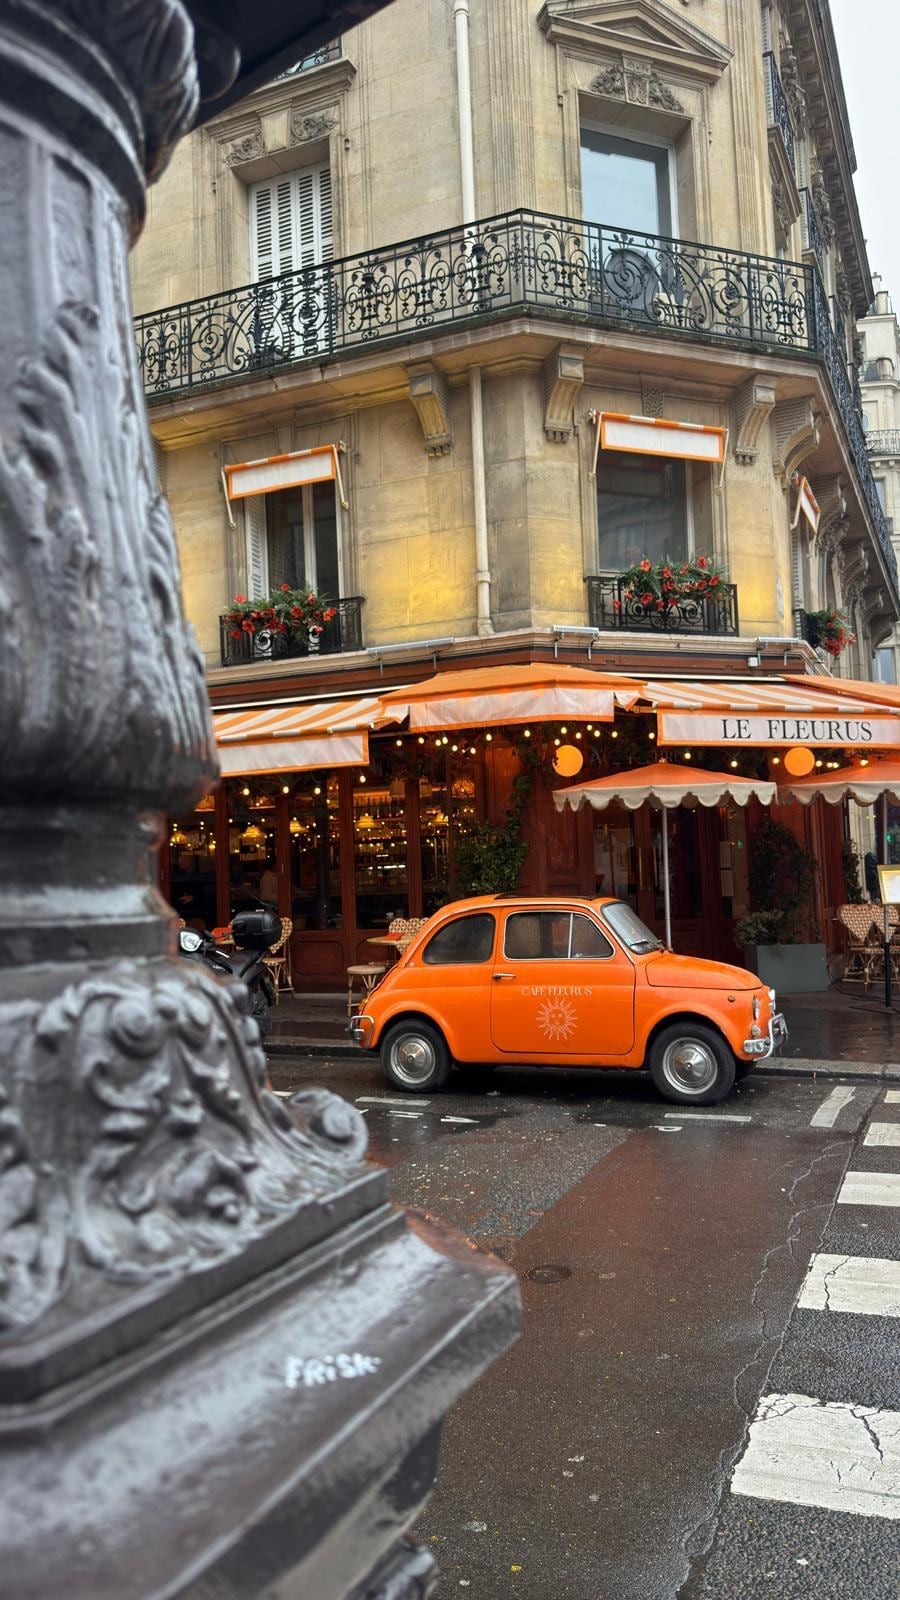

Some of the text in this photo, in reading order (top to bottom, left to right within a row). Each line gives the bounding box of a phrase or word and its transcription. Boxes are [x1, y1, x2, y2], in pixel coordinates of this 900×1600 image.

[721, 718, 873, 742] LE FLEURUS
[548, 985, 593, 996] FLEURUS
